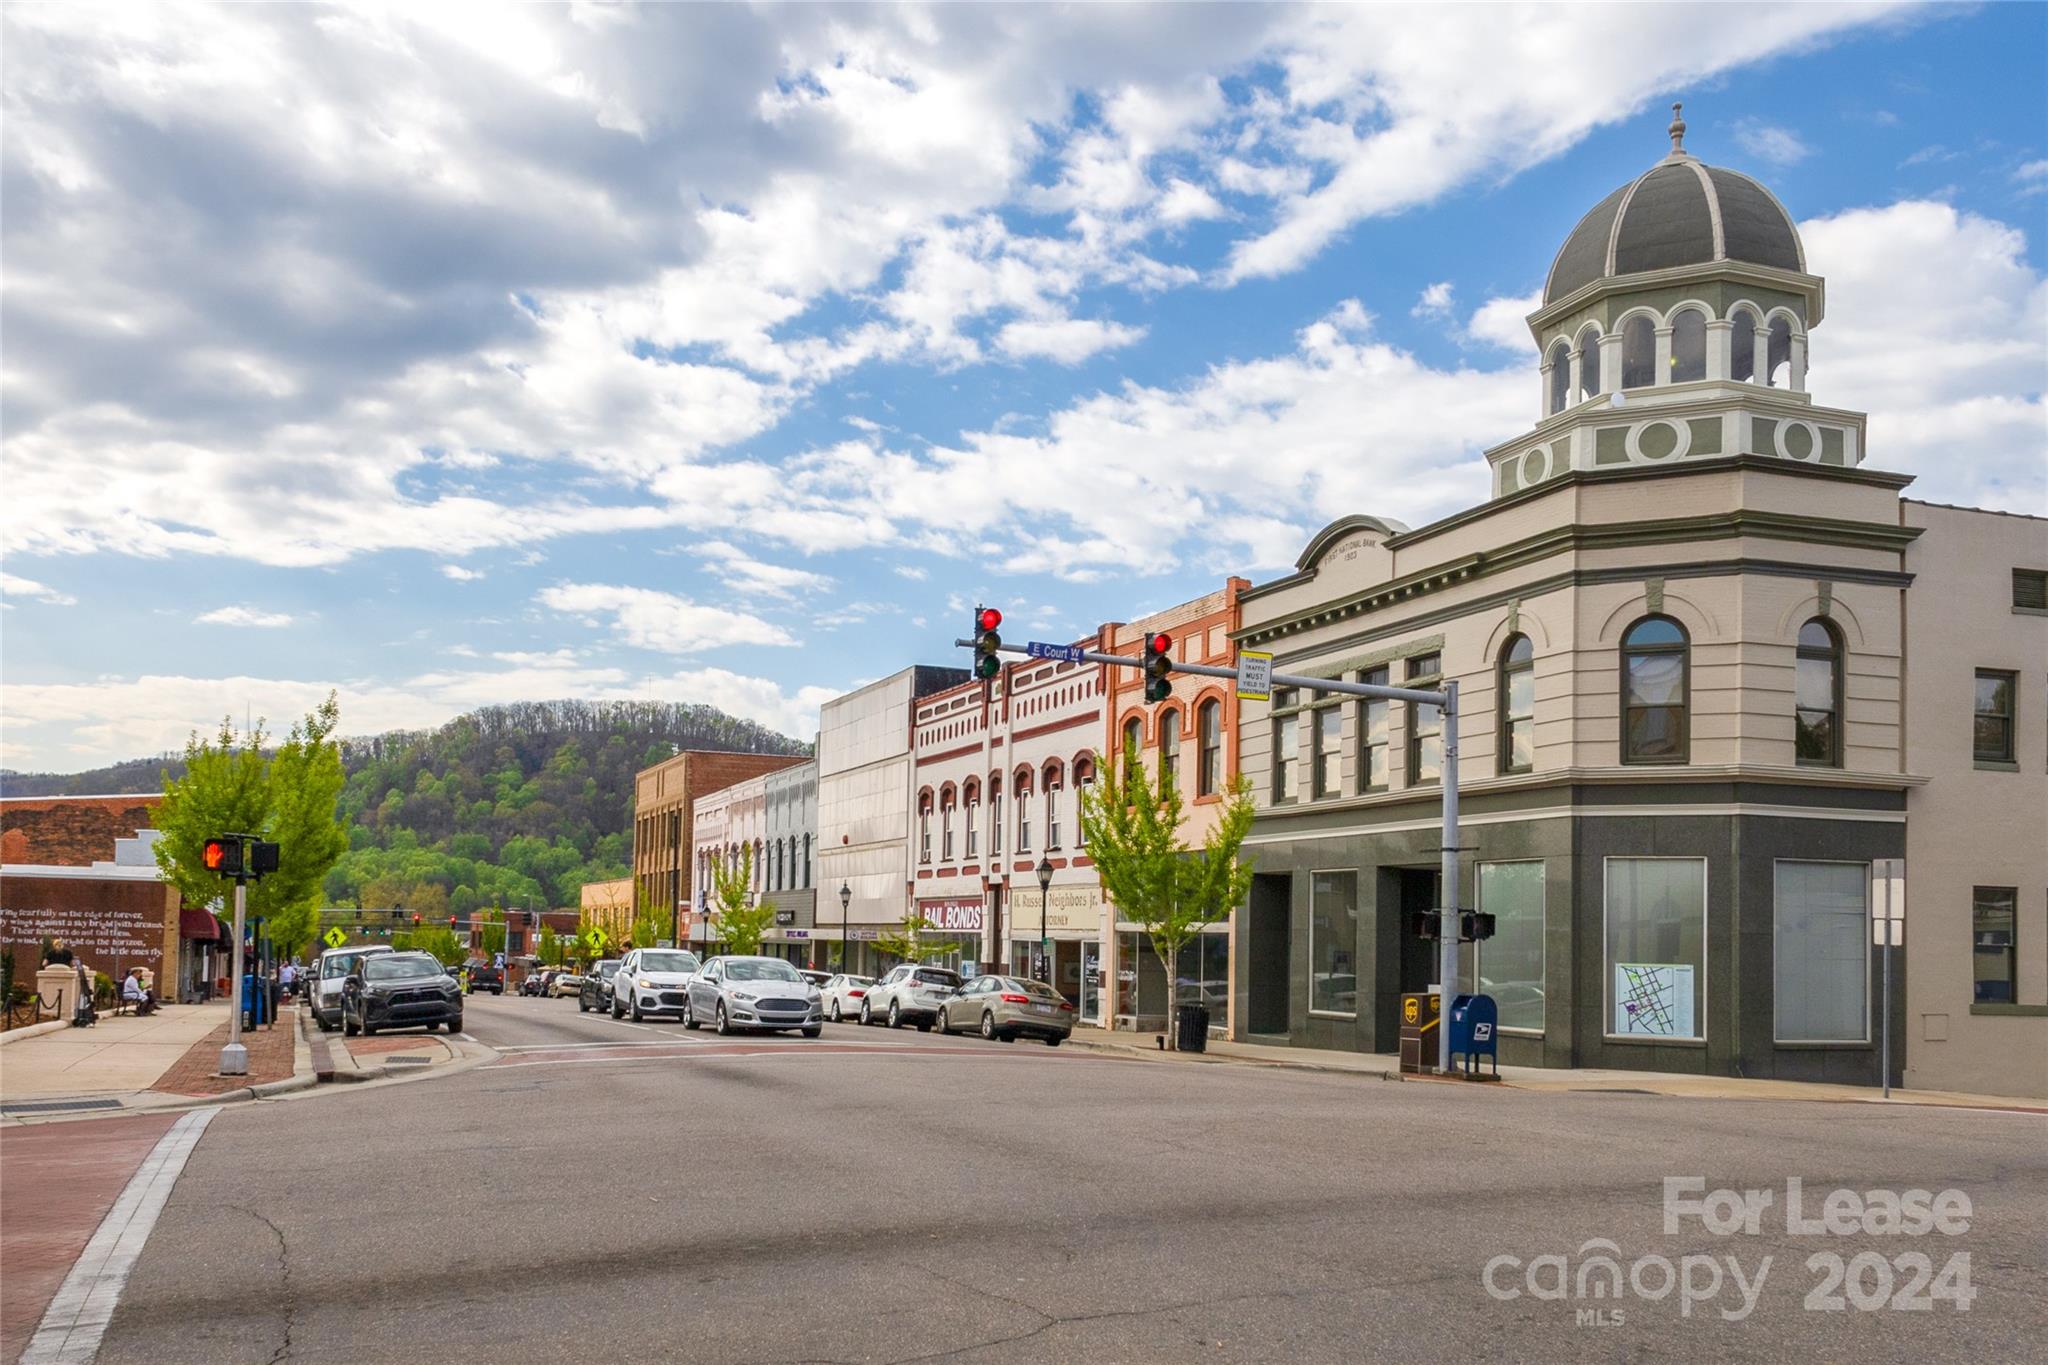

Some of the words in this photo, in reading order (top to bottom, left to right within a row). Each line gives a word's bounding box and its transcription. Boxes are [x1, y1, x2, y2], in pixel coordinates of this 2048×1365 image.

[1339, 541, 1361, 553] NATIONAL
[1362, 538, 1377, 548] BANK
[1033, 643, 1040, 653] E
[1043, 645, 1068, 659] Court
[1070, 647, 1080, 657] W
[1245, 664, 1266, 672] TRAFFIC
[1245, 671, 1264, 681] MUST
[1243, 680, 1258, 688] YIELD
[1022, 893, 1045, 908] Russe
[1048, 892, 1087, 910] Neighbors
[1089, 891, 1098, 909] Jr.
[19, 909, 56, 917] fearfully
[69, 910, 83, 918] the
[924, 906, 944, 928] BAIL
[945, 904, 981, 929] BONDS
[10, 919, 33, 928] wings
[34, 919, 66, 929] against
[74, 919, 87, 928] sky
[89, 920, 113, 929] bright
[1038, 914, 1069, 927] TORNEY
[11, 926, 34, 935] Their
[35, 927, 70, 936] feathers
[95, 928, 109, 936] fail
[112, 939, 146, 947] horizon,
[95, 947, 109, 955] the
[110, 947, 129, 956] litle
